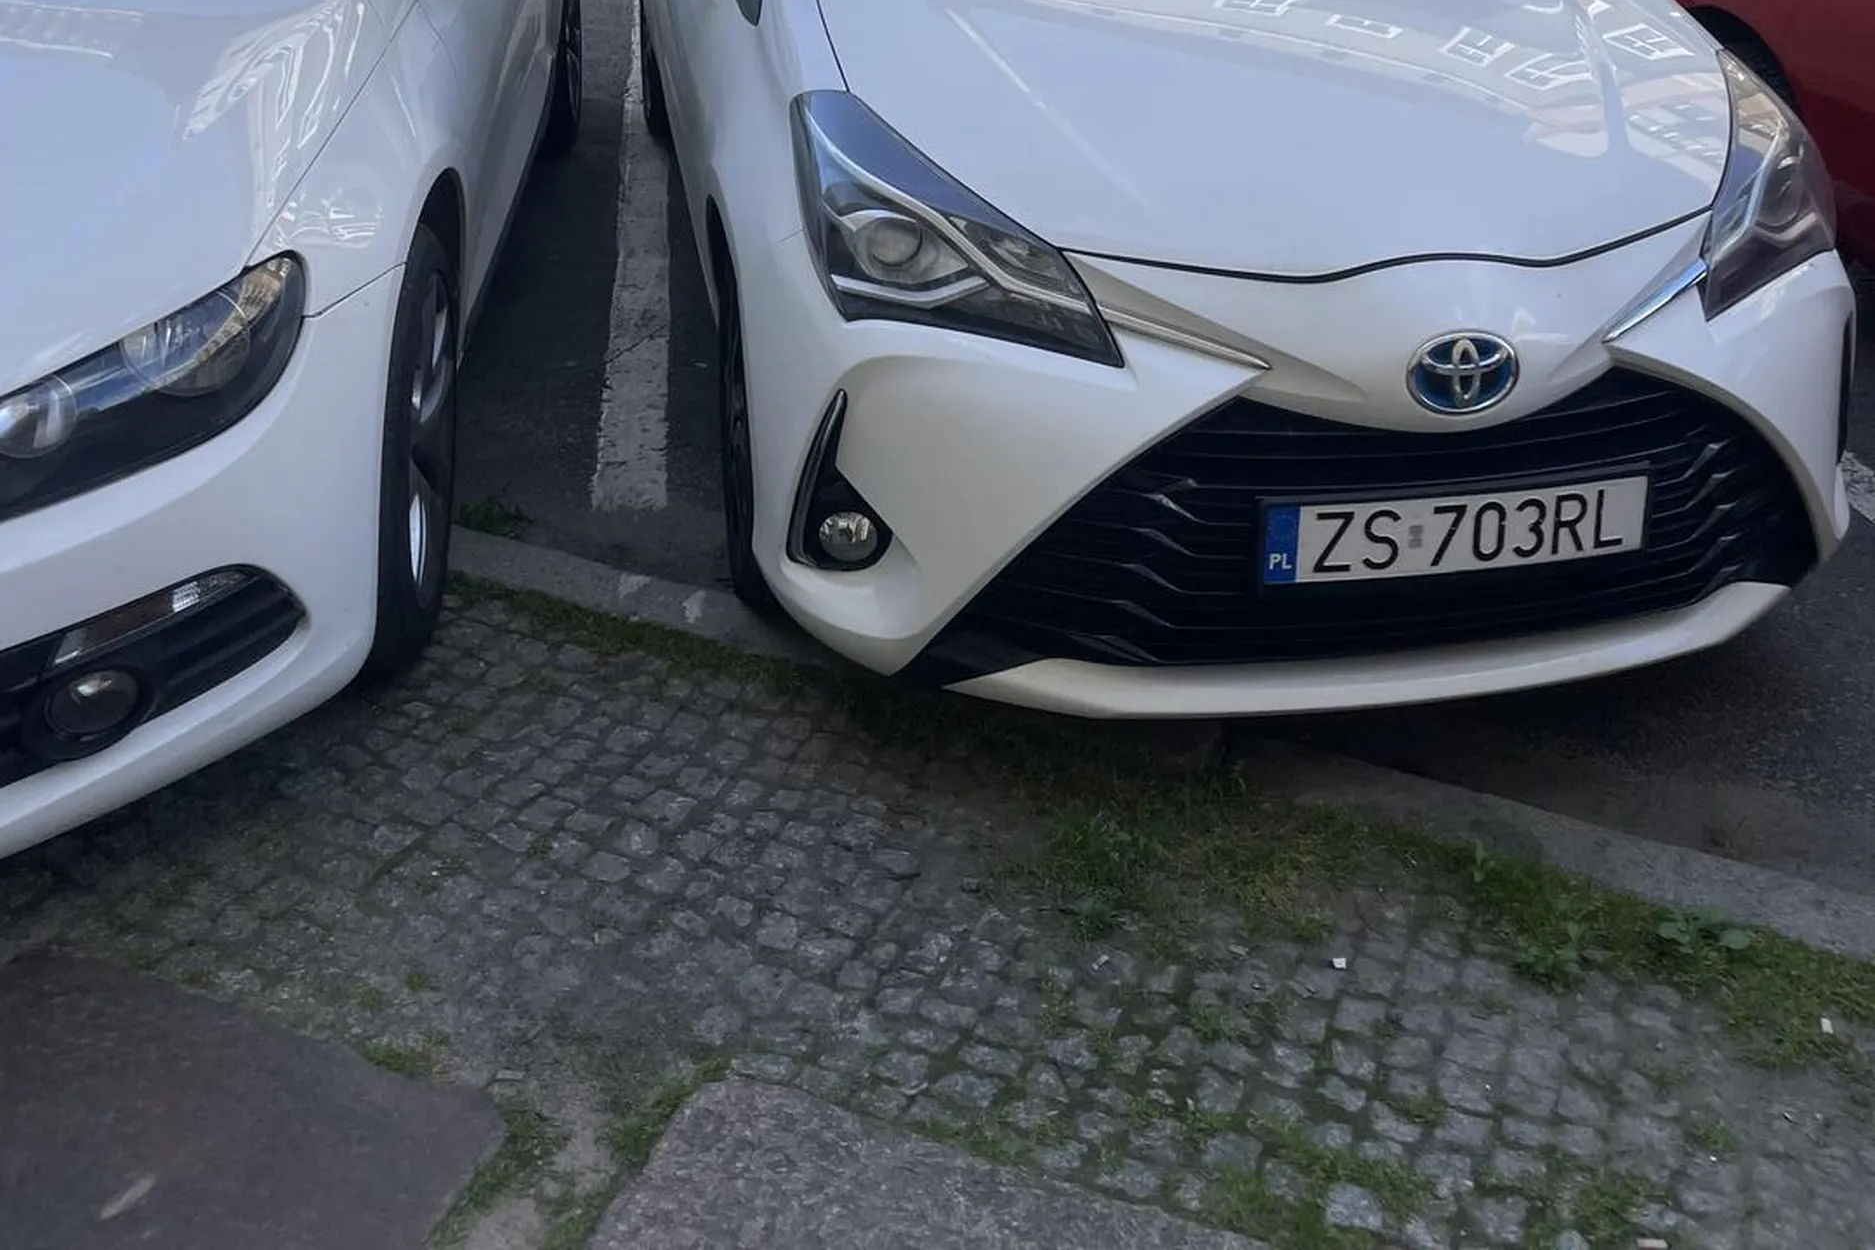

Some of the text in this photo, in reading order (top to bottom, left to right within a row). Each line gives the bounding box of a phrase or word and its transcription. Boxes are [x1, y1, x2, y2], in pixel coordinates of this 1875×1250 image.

[1312, 488, 1624, 573] ZS 703RL
[1268, 552, 1293, 570] PL
